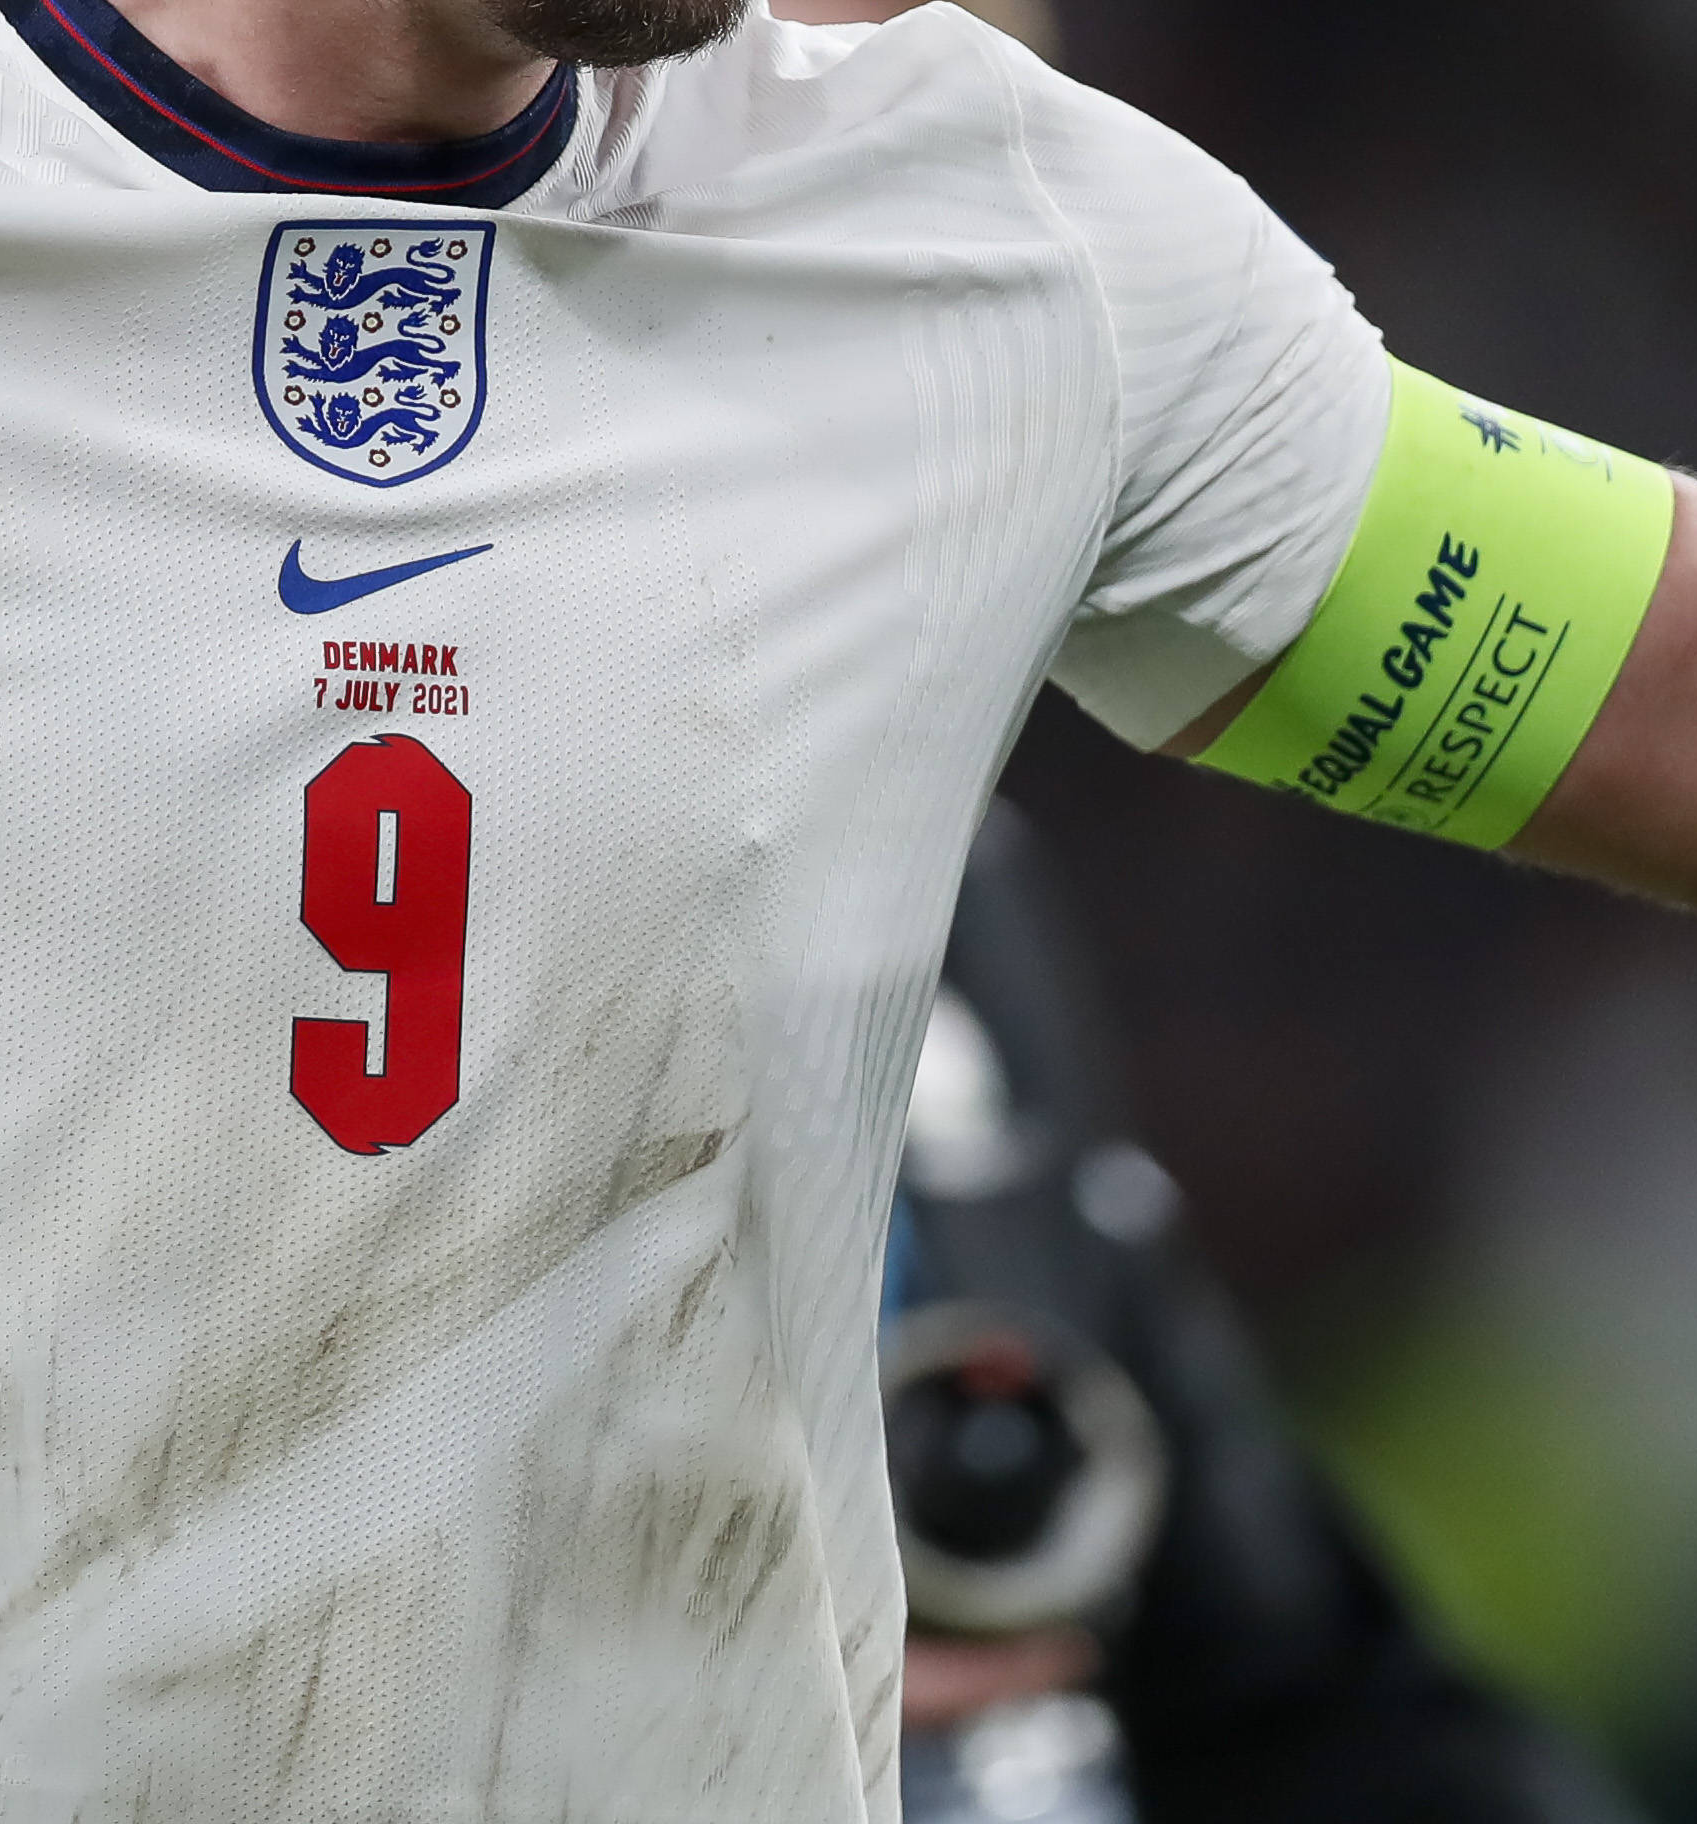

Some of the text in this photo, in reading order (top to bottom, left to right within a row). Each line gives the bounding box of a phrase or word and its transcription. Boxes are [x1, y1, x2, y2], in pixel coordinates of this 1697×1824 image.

[323, 641, 458, 677] DENMARK
[1382, 531, 1479, 690] GAME
[313, 677, 469, 716] 7 JULY 2021
[1405, 601, 1549, 804] RESPECT
[290, 732, 473, 1156] 9
